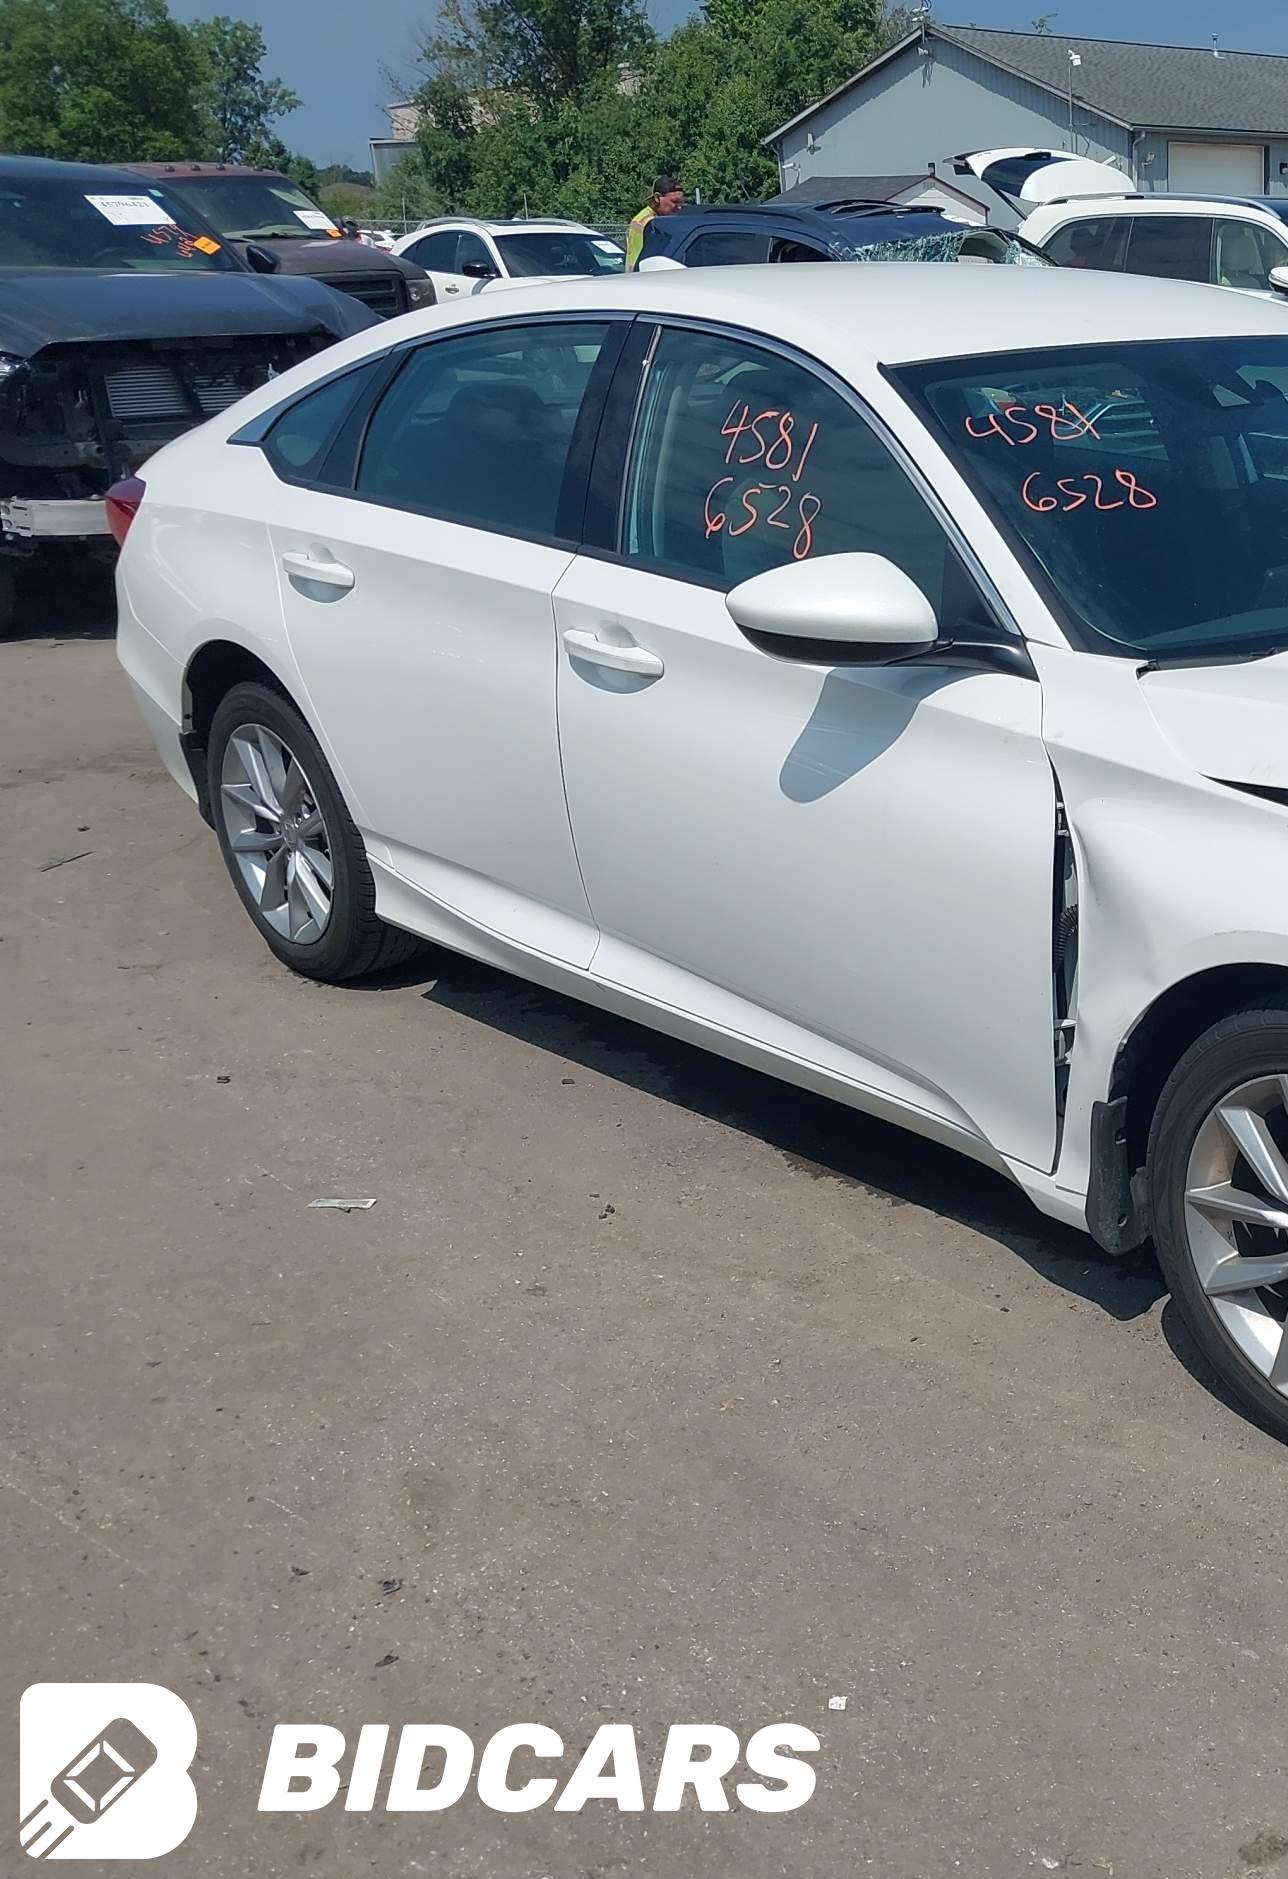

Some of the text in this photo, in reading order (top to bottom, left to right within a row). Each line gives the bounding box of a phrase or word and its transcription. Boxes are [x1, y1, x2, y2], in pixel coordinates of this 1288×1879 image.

[721, 399, 819, 482] 4581
[965, 402, 1101, 446] 4581
[704, 476, 821, 560] 6528
[1022, 469, 1157, 512] 6528
